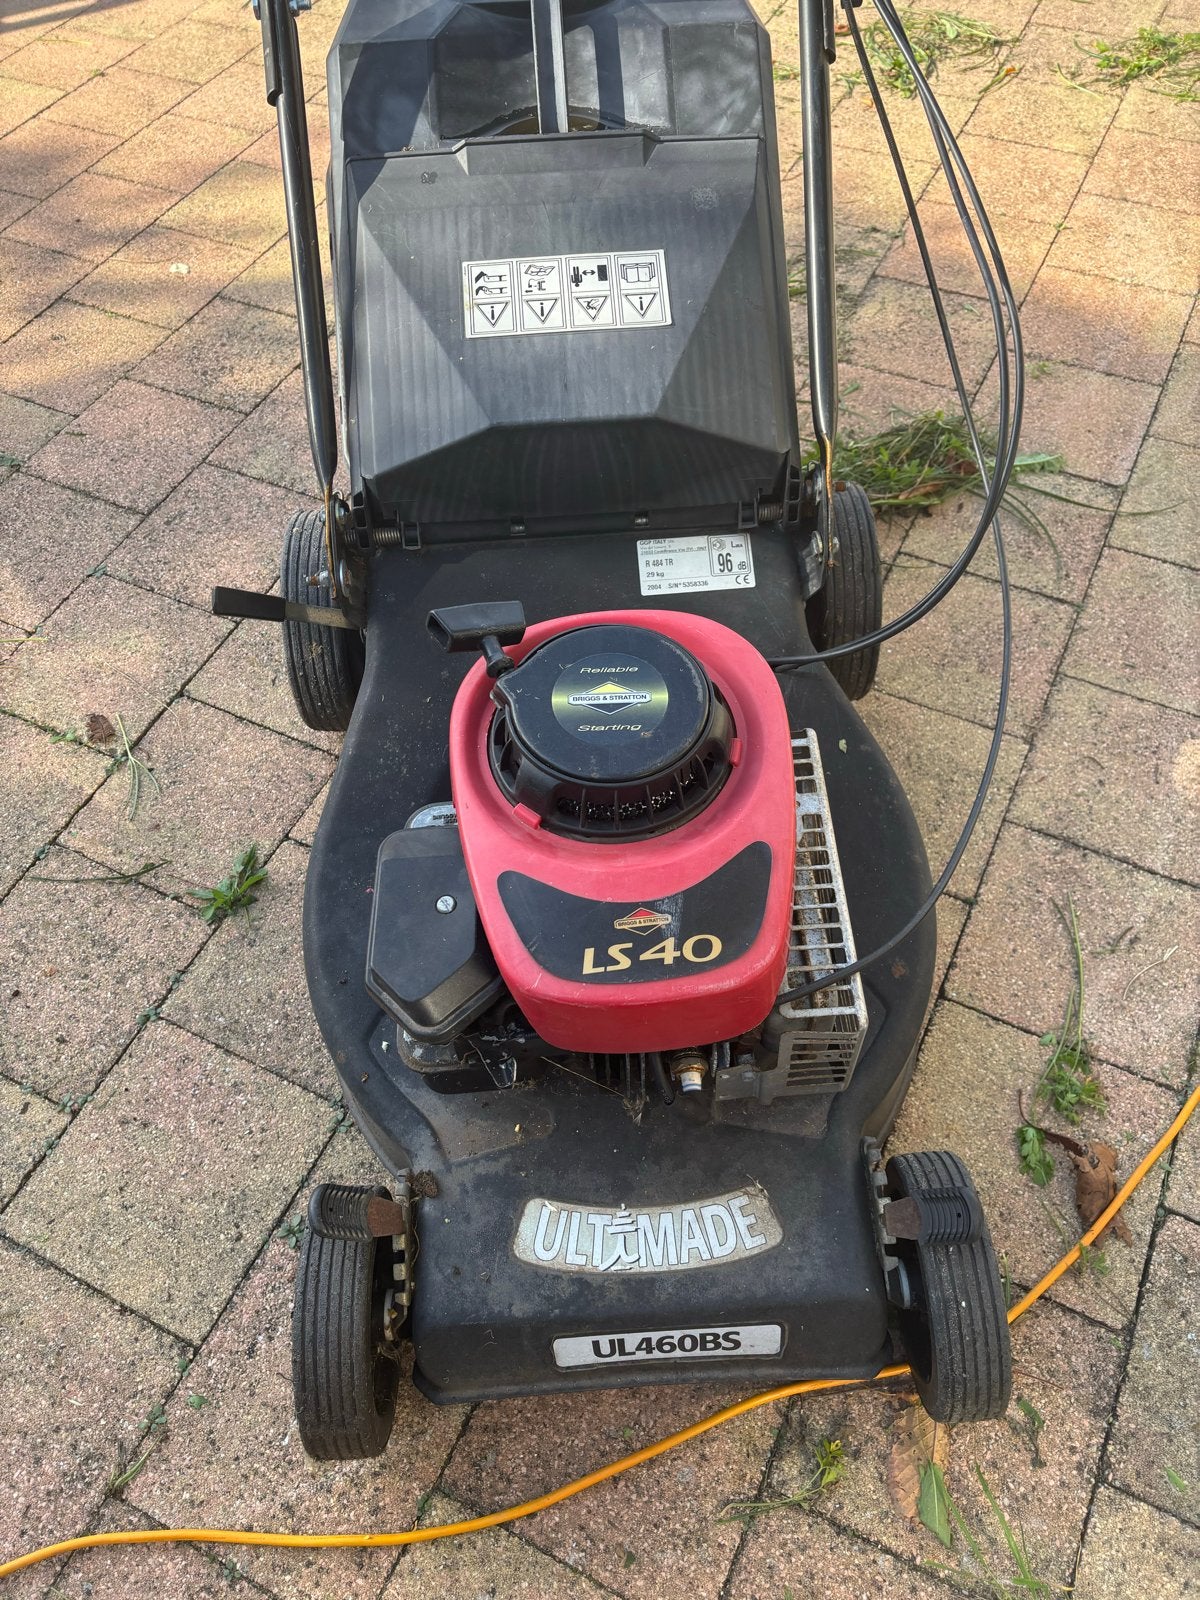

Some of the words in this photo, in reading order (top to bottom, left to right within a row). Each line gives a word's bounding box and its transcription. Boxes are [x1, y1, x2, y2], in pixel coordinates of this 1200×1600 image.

[645, 559, 651, 568] R
[652, 559, 663, 567] 484
[664, 558, 674, 567] TR
[717, 552, 733, 573] 96
[737, 560, 747, 571] dB
[682, 580, 709, 588] 5358336
[579, 666, 639, 674] Reliable
[577, 724, 642, 732] Starting
[582, 942, 633, 975] LS
[639, 934, 723, 965] 40
[592, 1332, 742, 1358] UL460BS
